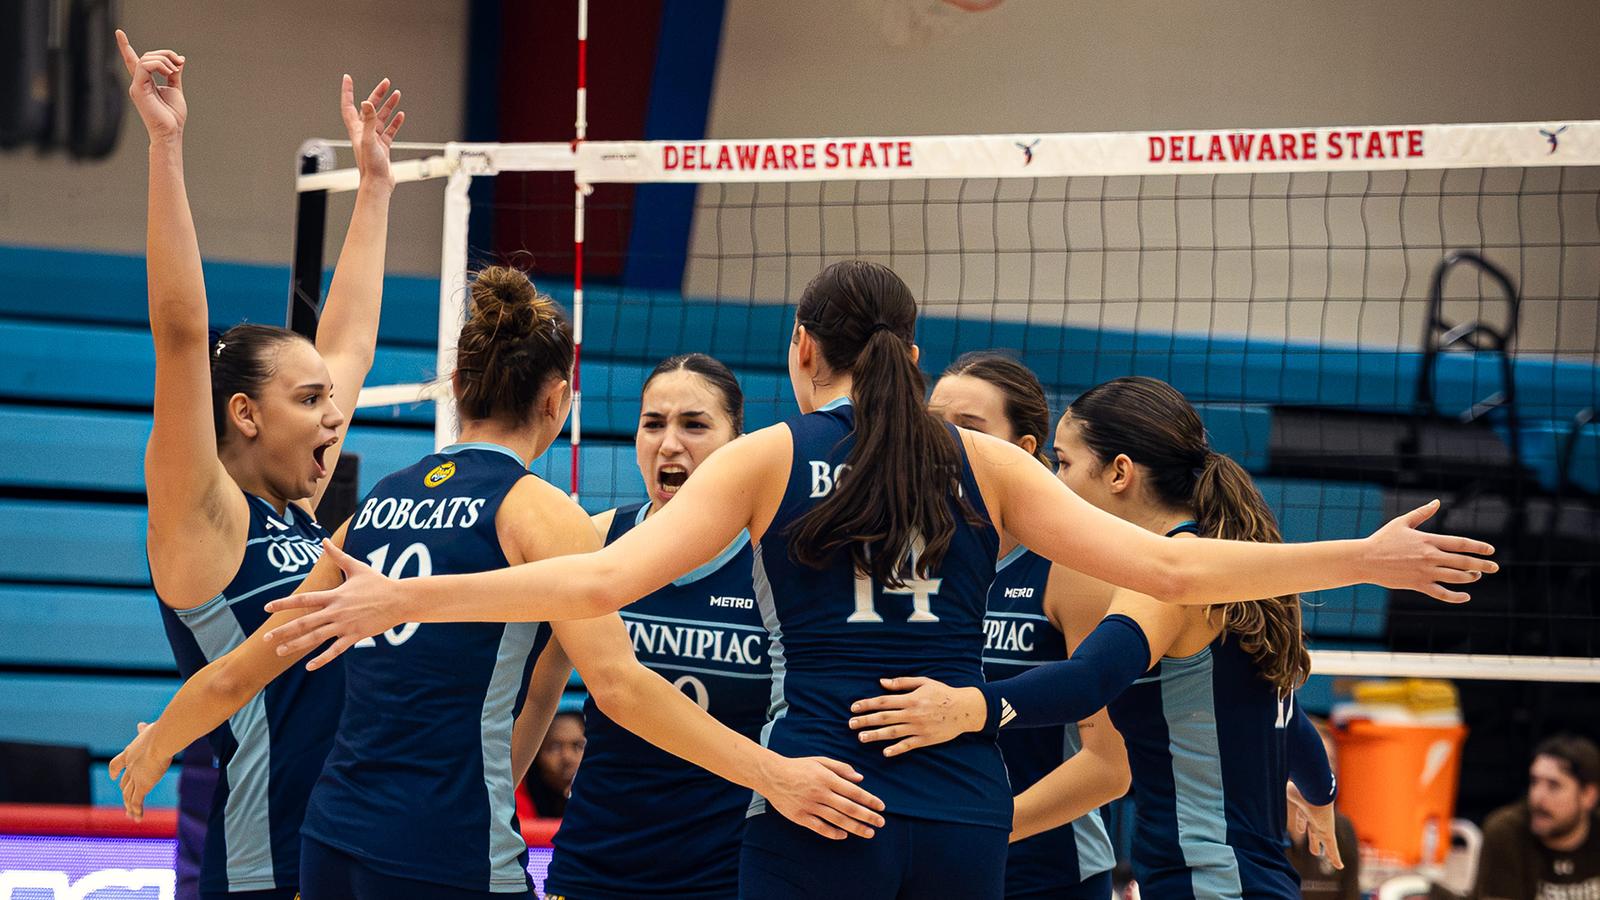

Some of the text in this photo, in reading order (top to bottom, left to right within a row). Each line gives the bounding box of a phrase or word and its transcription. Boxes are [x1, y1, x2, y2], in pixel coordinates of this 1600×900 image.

[663, 142, 913, 170] DELAWARE STATE
[1149, 130, 1424, 162] DELAWARE STATE
[353, 497, 486, 531] BOBCATS
[709, 596, 754, 609] METRO
